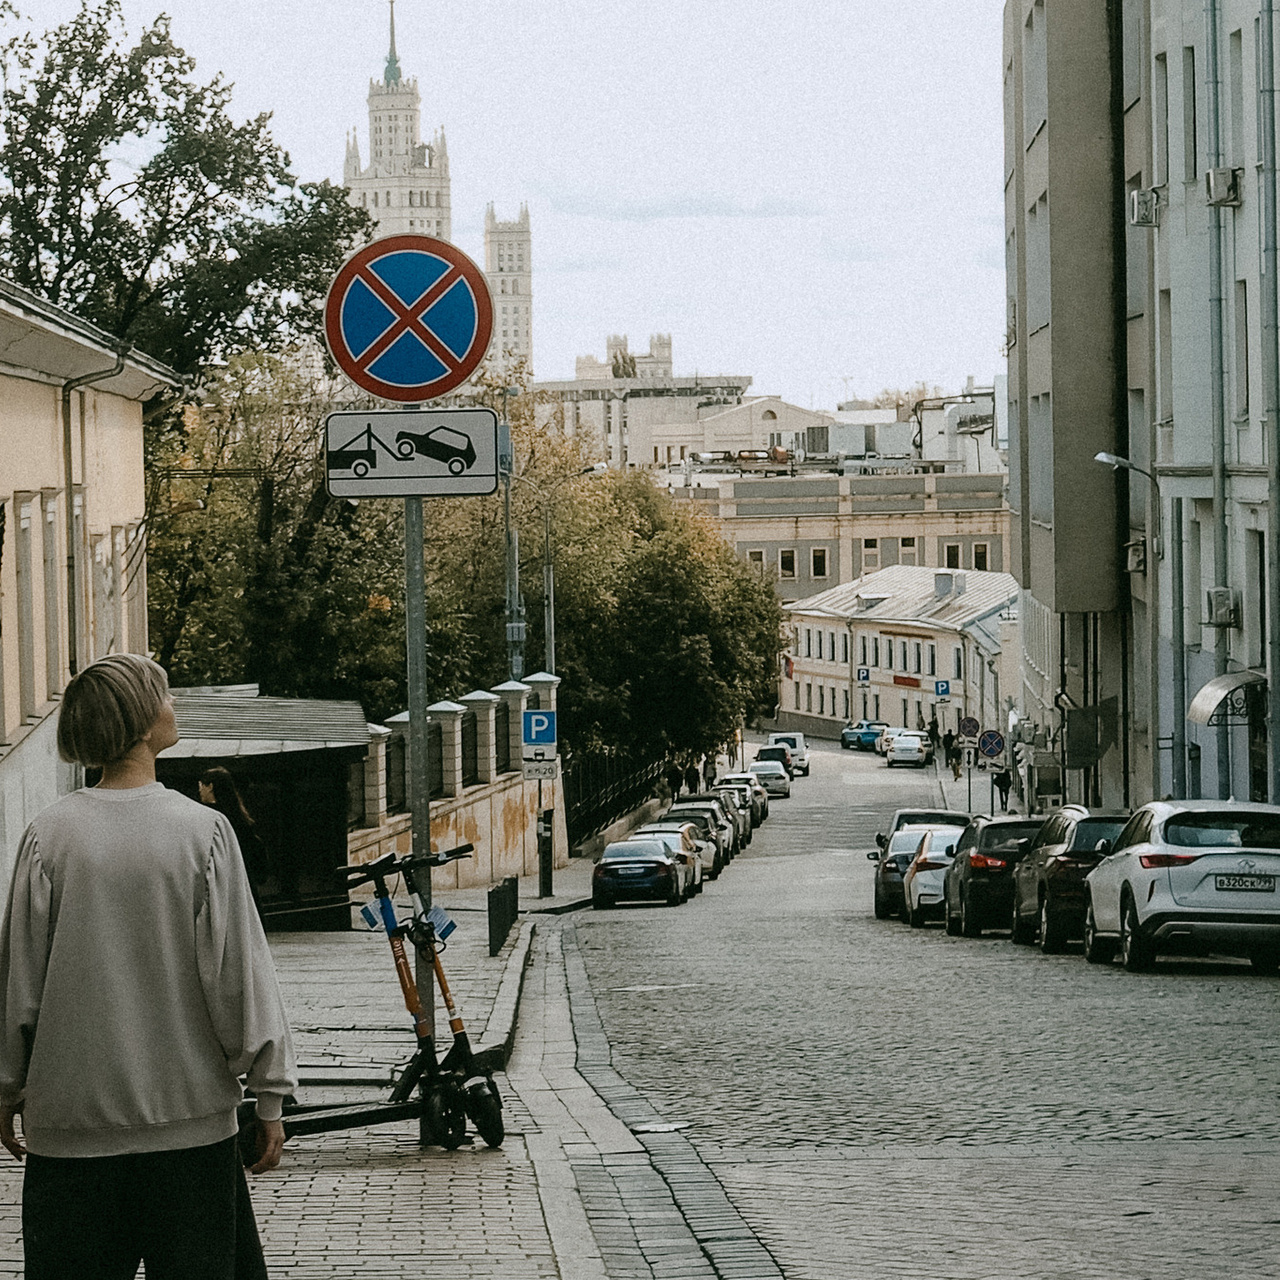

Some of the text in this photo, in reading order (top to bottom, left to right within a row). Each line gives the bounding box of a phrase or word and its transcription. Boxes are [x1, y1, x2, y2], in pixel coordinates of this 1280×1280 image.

[860, 669, 867, 680] P
[938, 682, 947, 694] P
[531, 715, 549, 740] P
